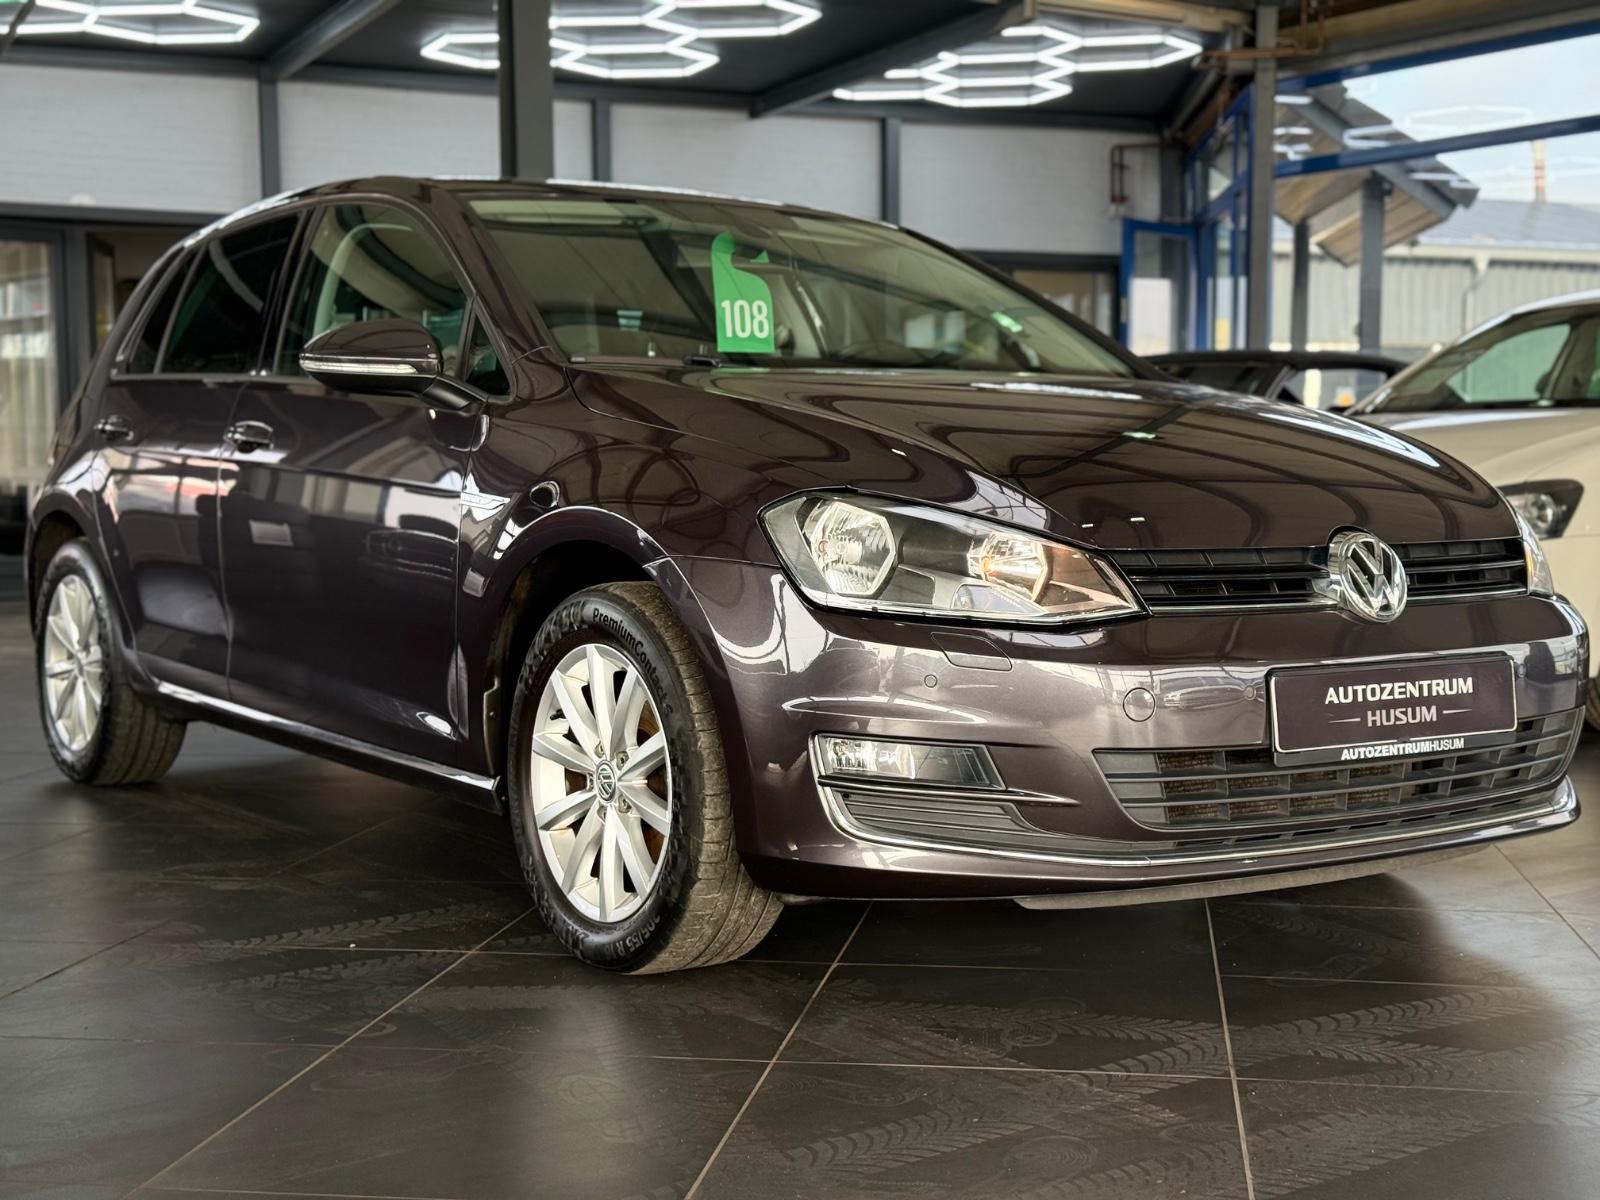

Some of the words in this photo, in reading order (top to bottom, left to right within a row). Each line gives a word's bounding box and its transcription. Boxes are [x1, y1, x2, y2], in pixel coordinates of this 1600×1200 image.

[721, 299, 769, 338] 108
[592, 607, 668, 699] PremiumContact
[1325, 677, 1473, 705] AUTOZENTRUM
[1367, 705, 1437, 727] HUSUM
[1340, 738, 1465, 761] AUTOZENTRUMHUSUM
